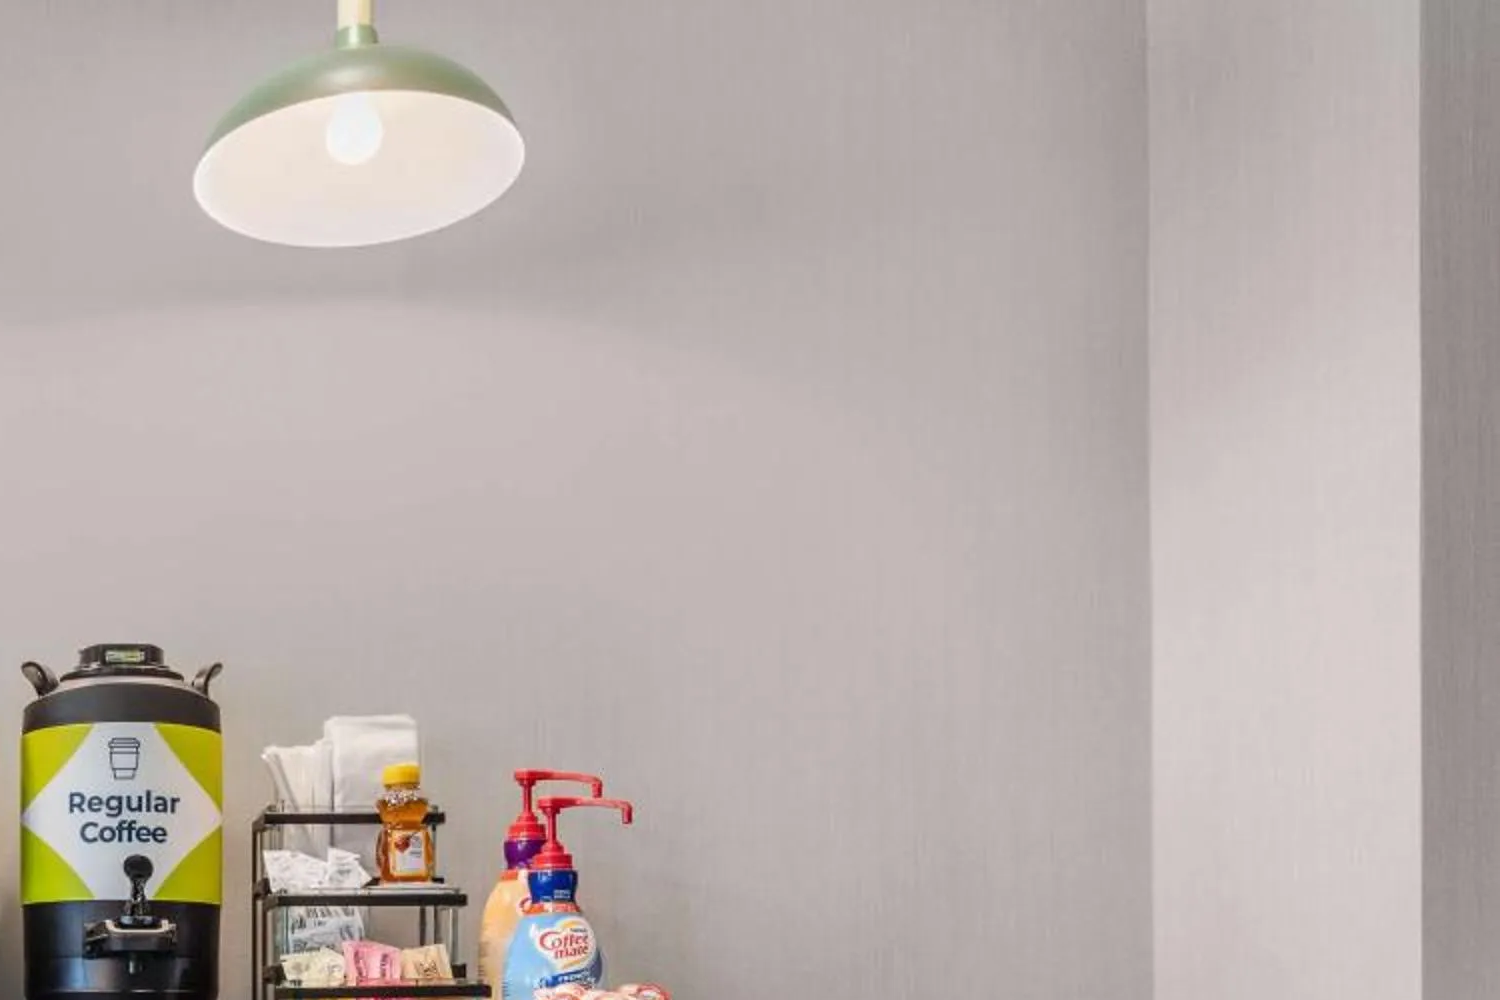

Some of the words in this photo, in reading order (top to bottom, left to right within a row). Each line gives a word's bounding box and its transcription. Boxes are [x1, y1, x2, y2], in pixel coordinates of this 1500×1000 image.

[68, 789, 181, 818] Regular
[80, 819, 168, 843] Coffee
[539, 931, 589, 951] Coffee
